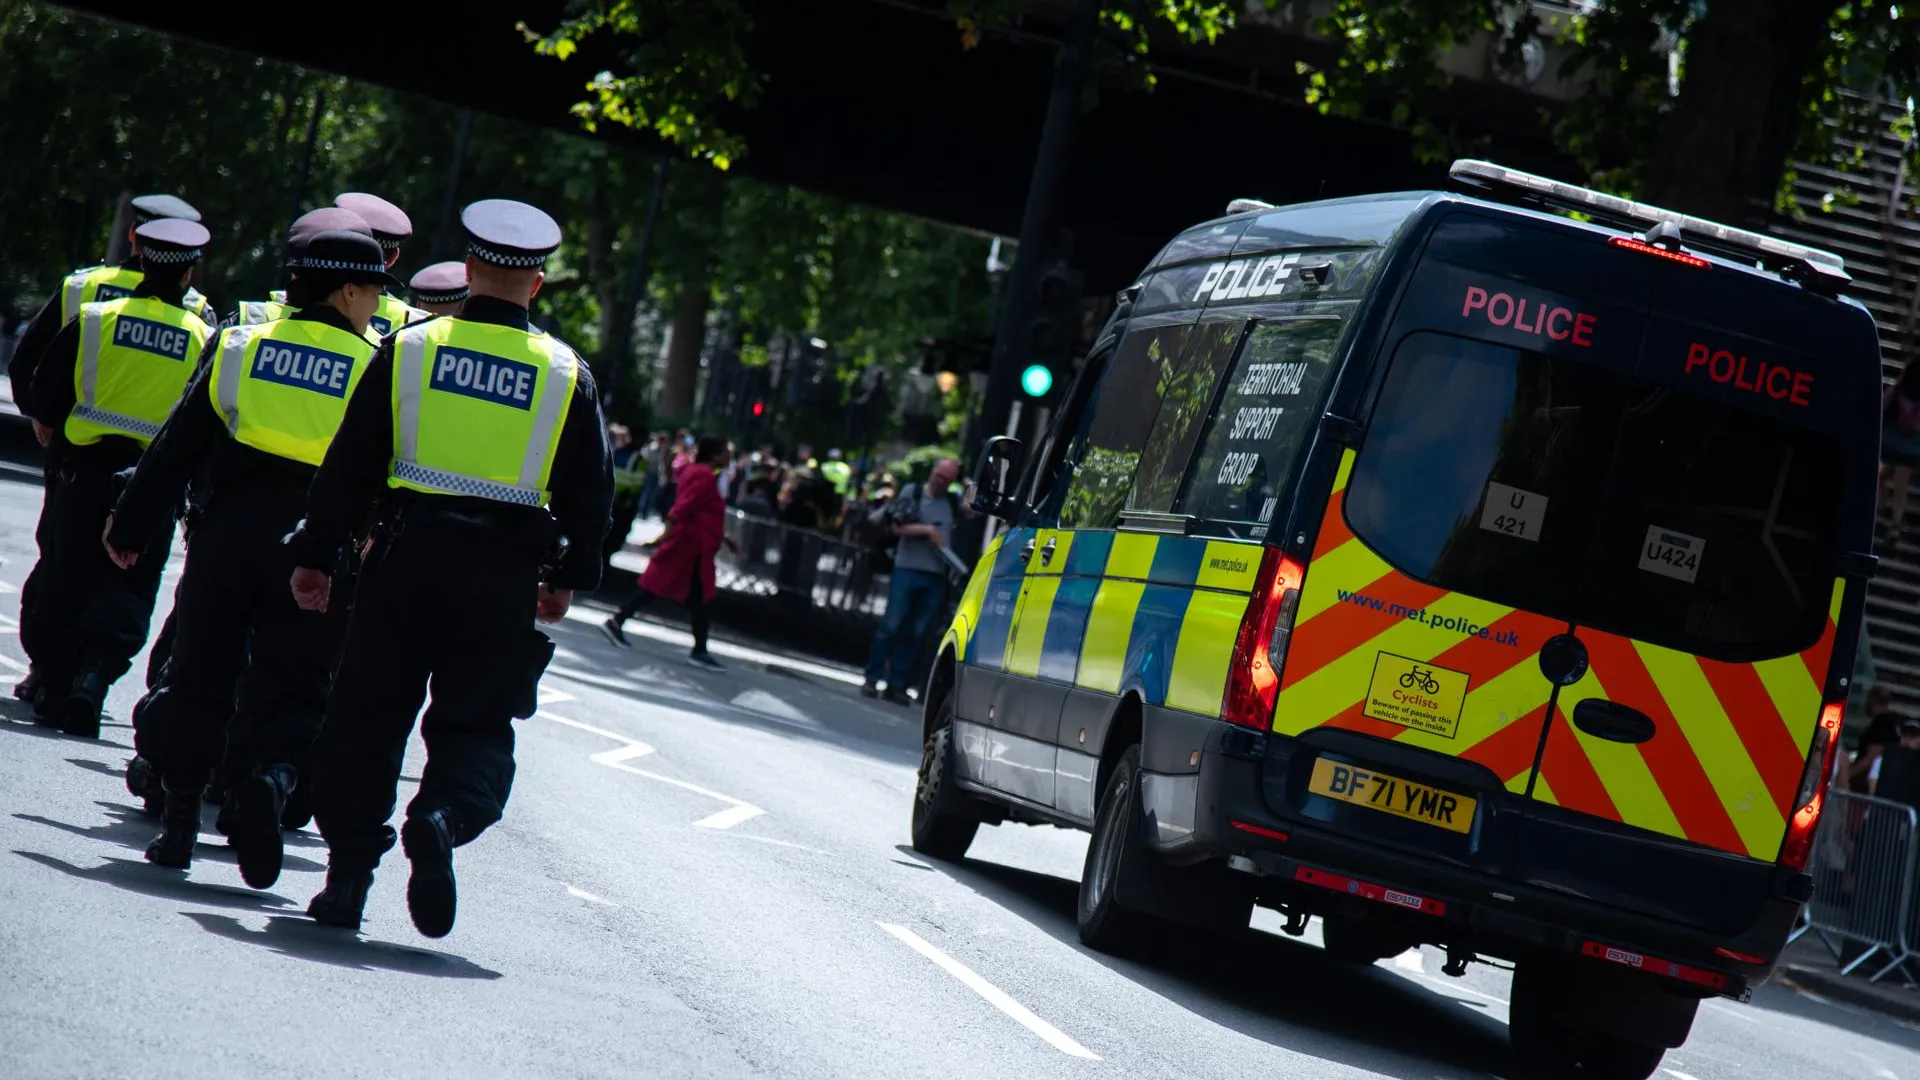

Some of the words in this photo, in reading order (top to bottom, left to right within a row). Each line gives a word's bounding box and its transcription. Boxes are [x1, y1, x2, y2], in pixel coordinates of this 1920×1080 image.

[1192, 253, 1301, 302] POLICE
[1462, 286, 1597, 347] POLICE
[116, 321, 187, 355] POLICE
[256, 346, 347, 391] POLICE
[436, 352, 533, 402] POLICE
[1239, 362, 1308, 395] TERRITORIAL
[1684, 342, 1815, 407] POLICE
[1229, 407, 1284, 440] SUPPORT
[1217, 452, 1259, 485] GROUP
[1510, 492, 1525, 510] U
[1494, 515, 1526, 536] 421
[1647, 541, 1698, 571] U424
[1337, 588, 1520, 647] www.met.police.uk
[1372, 698, 1400, 711] Beware
[1410, 709, 1437, 723] passing
[1438, 716, 1452, 725] this
[1392, 689, 1439, 710] Cyclists
[1373, 709, 1399, 720] vehicle
[1411, 718, 1424, 727] the
[1425, 722, 1447, 732] inside
[1329, 765, 1396, 808] BF71
[1405, 785, 1457, 824] YMR
